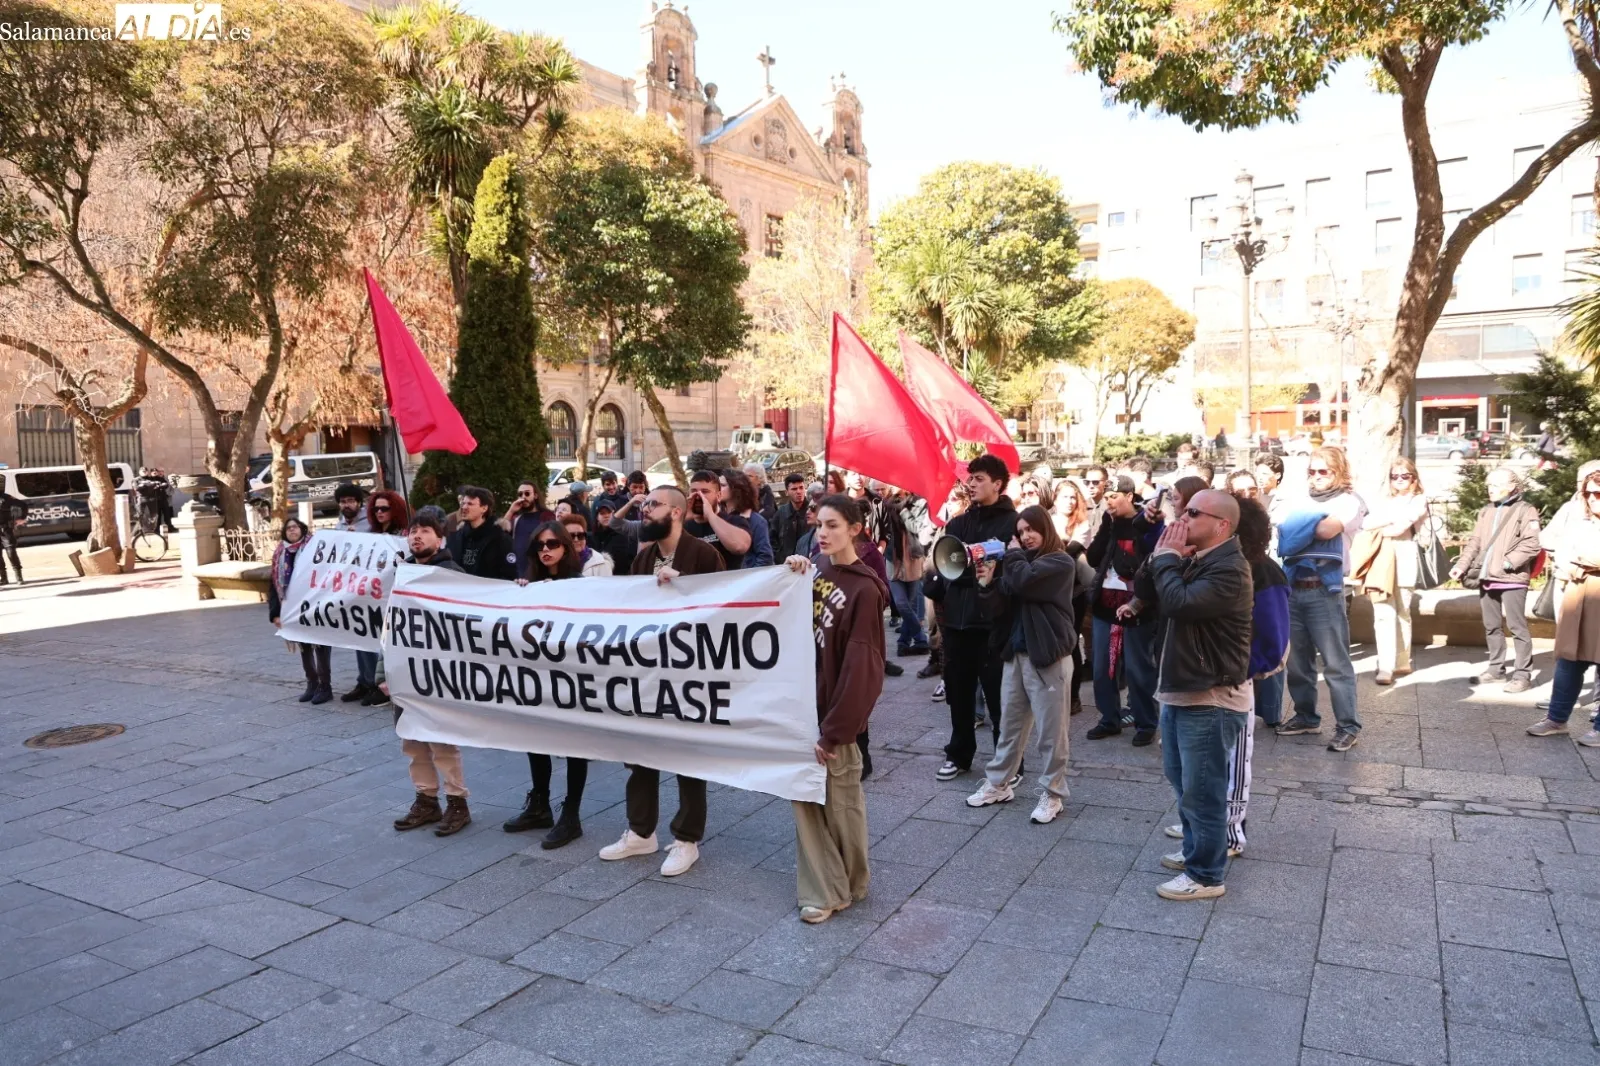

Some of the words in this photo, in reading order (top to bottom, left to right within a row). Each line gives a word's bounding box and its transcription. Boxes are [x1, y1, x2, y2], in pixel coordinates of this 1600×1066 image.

[26, 510, 86, 522] NACIONAL
[385, 606, 487, 655] RENTE
[492, 617, 519, 658] A
[521, 618, 574, 662] SU
[577, 620, 781, 670] RACISMO
[408, 657, 543, 706] UNIDAD
[550, 669, 604, 713] DE
[606, 676, 731, 725] CLASE
